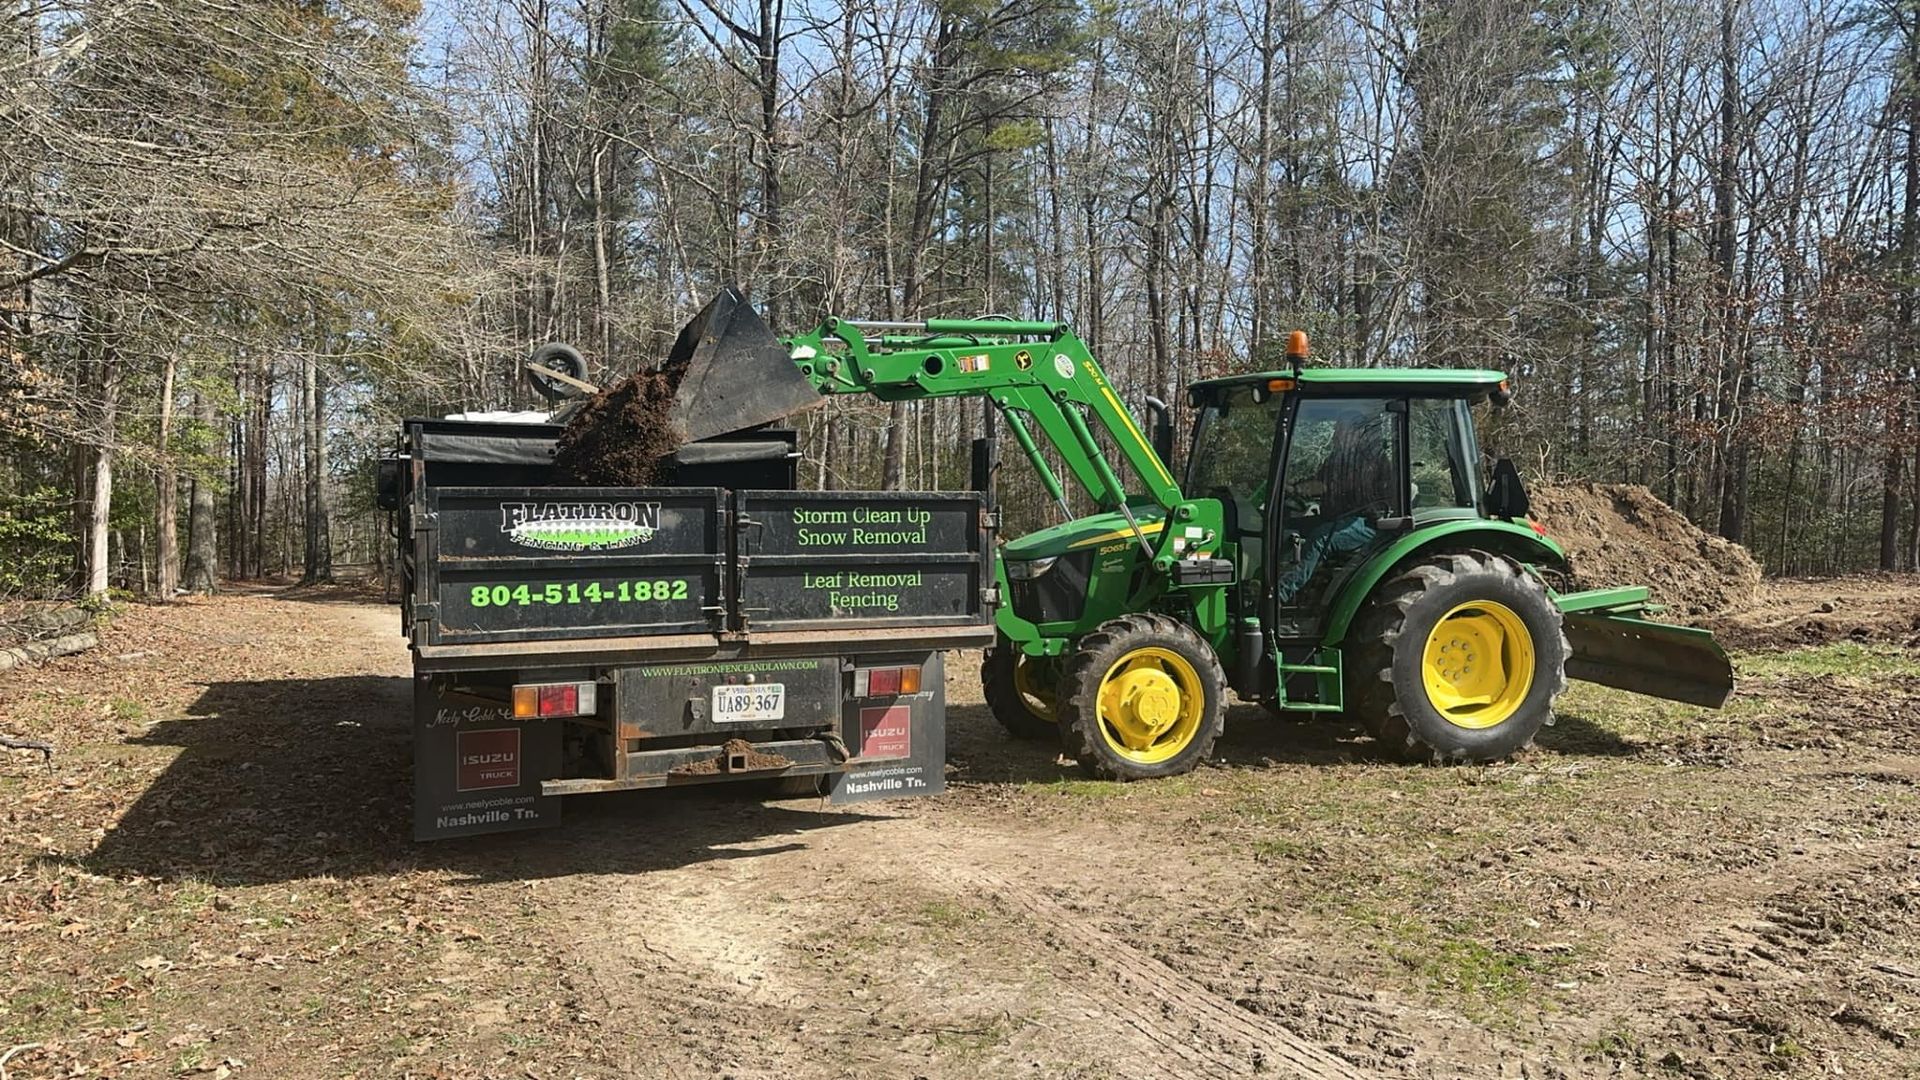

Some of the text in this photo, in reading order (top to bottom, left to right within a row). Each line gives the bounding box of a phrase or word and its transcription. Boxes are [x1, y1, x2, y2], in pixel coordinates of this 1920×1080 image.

[500, 502, 661, 533] FLATIRON
[793, 506, 931, 529] Storm Clean Up
[510, 531, 653, 551] FENCING & LAWN
[798, 527, 927, 546] Snow Removal
[804, 570, 923, 589] Leaf Removal
[470, 580, 689, 608] 804-514-1882
[829, 591, 899, 611] Fencing
[641, 660, 819, 678] WWW.FLATIRONFENCEANDLAWN.COM
[865, 727, 906, 738] ISUZU
[463, 752, 514, 766] ISUZU
[480, 771, 513, 780] TRUCK
[849, 766, 923, 779] www.neelycoble.com
[846, 776, 927, 795] Nashville Tn.
[442, 795, 535, 812] www.neelycoble.com
[437, 808, 539, 829] Nashville Tn.
